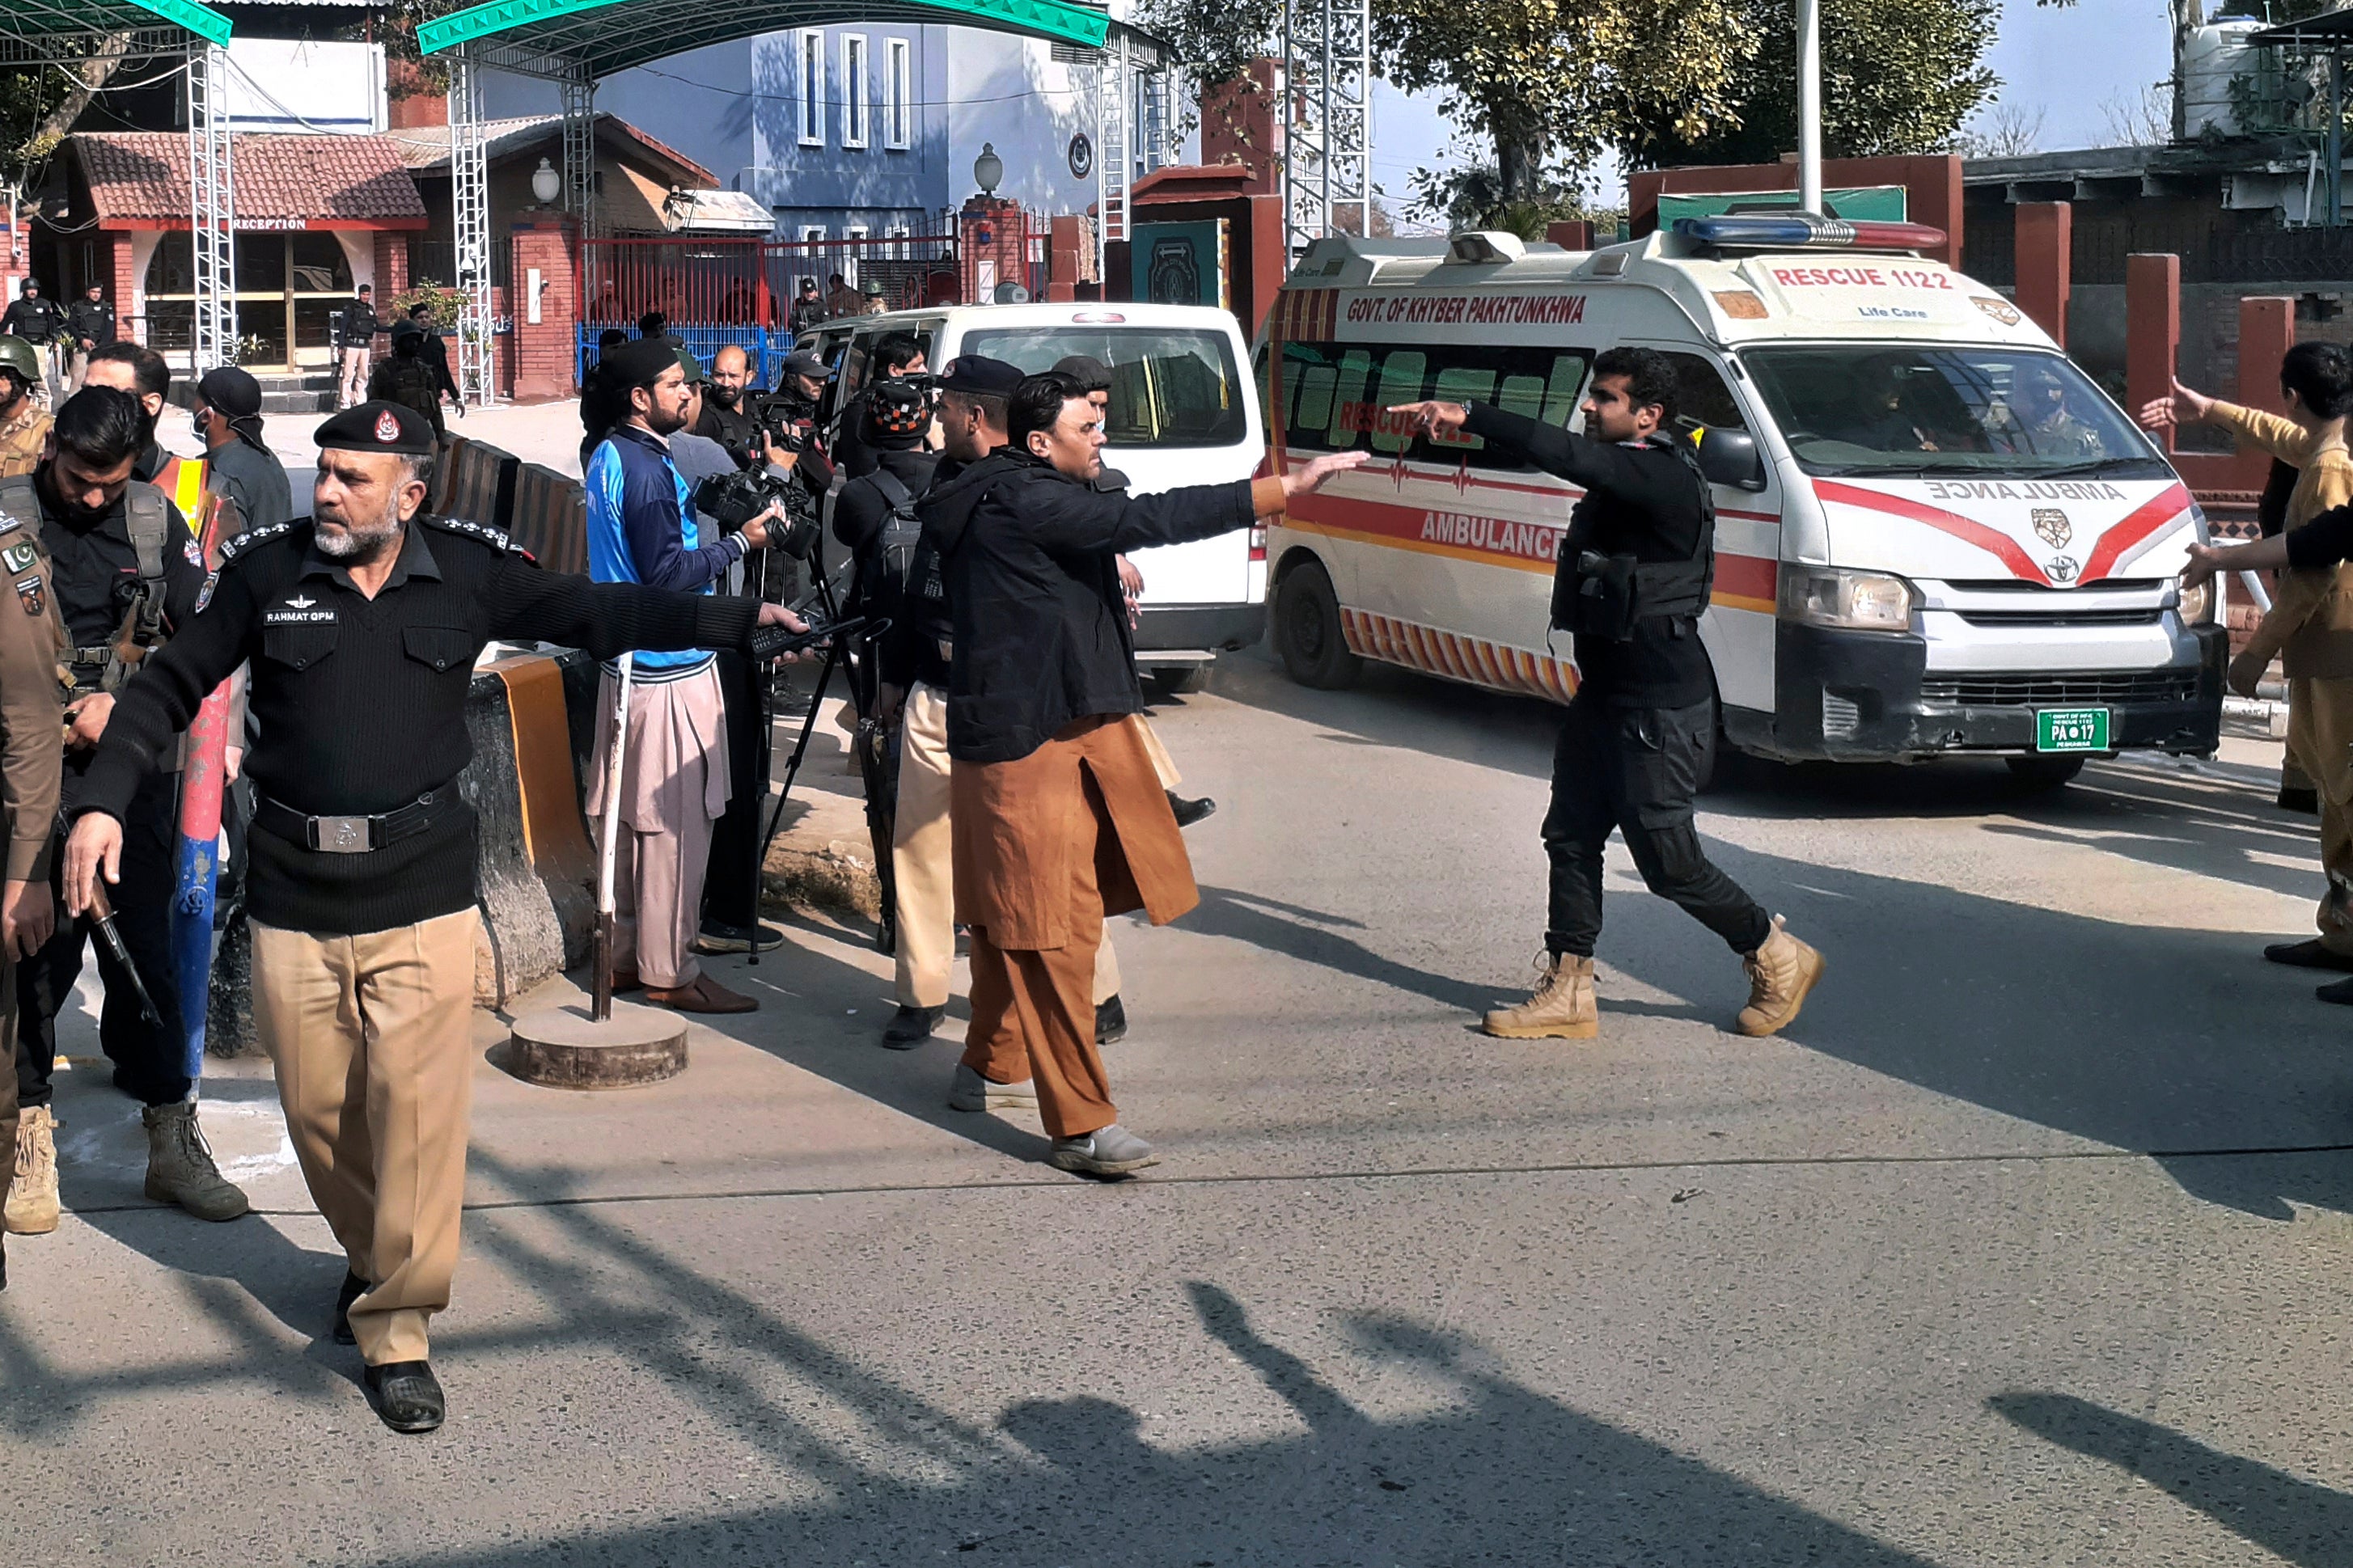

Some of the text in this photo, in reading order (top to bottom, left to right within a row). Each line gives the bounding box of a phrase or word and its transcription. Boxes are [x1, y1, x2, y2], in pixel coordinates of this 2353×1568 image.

[233, 218, 306, 230] RECEPTION
[1772, 268, 1954, 290] RESCUE 1122
[1347, 295, 1587, 323] GOVT. OF KHYBER PAKHTUNKHWA
[1857, 306, 1929, 319] Life Care
[267, 612, 309, 622] RAHMAT
[2051, 725, 2094, 741] PA 17
